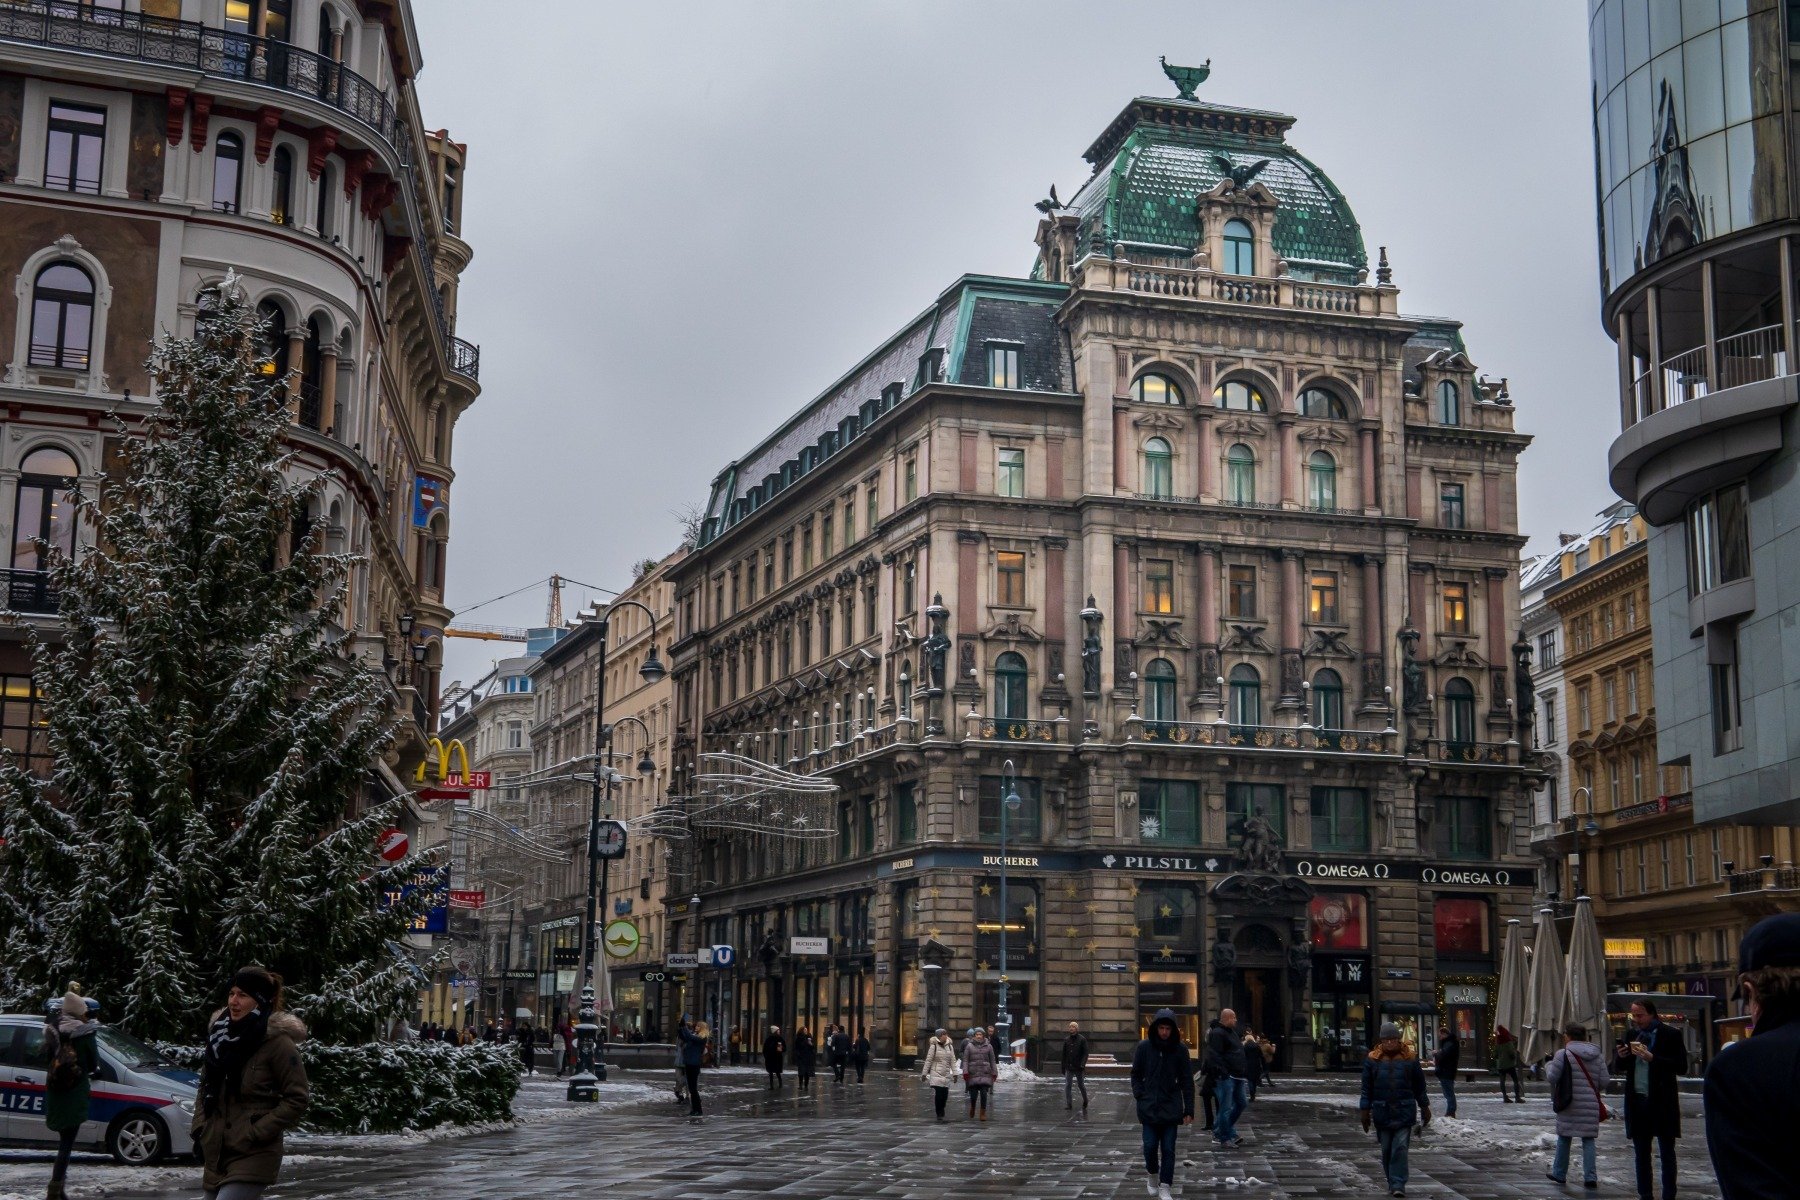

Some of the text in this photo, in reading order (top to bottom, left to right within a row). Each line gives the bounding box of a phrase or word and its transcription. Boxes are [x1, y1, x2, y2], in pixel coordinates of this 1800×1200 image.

[1124, 856, 1198, 870] PILSTL
[1317, 865, 1369, 878] OMEGA
[1440, 871, 1491, 884] OMEGA
[669, 956, 697, 965] claire's
[717, 949, 731, 964] U
[1453, 995, 1481, 1003] OMEGA
